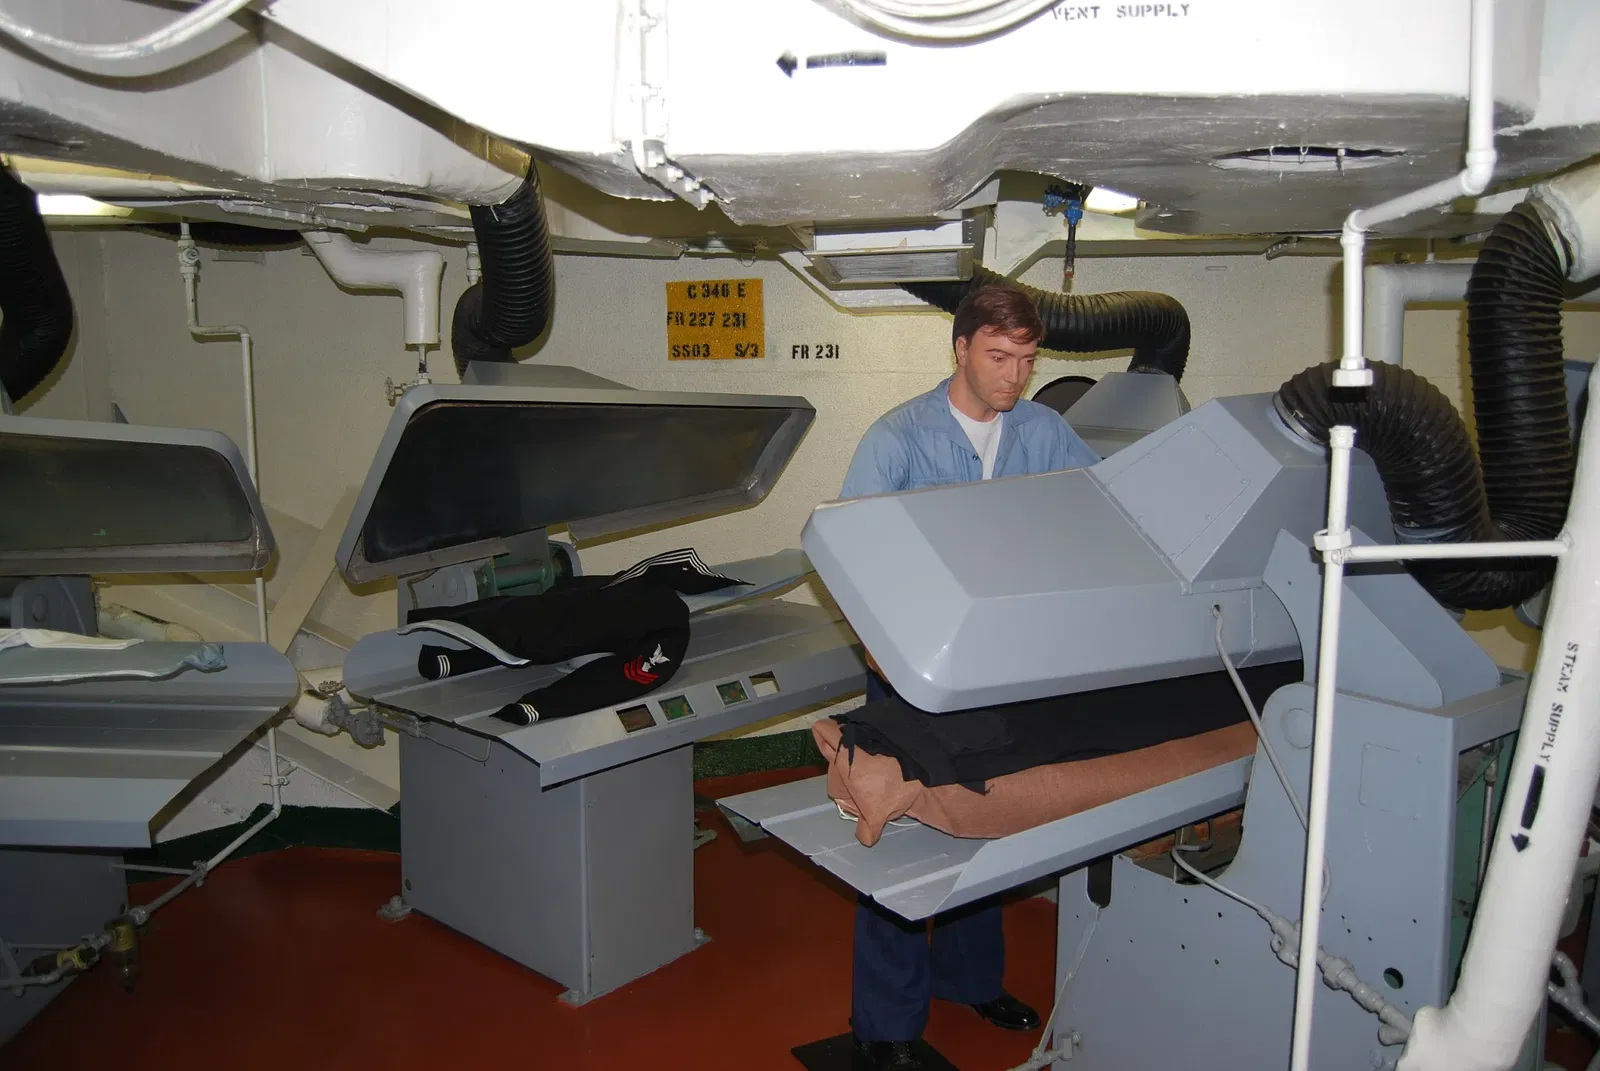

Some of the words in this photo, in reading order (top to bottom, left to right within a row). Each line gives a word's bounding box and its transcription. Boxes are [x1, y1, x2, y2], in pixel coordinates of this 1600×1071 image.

[1051, 6, 1100, 21] VENT
[1116, 4, 1189, 18] SUPPLY
[687, 284, 697, 299] C
[738, 282, 746, 298] E
[667, 312, 684, 326] FR
[689, 312, 715, 327] 227
[722, 312, 747, 328] 231
[672, 343, 711, 358] SS03
[735, 342, 759, 358] S/3
[792, 344, 809, 360] FR
[815, 343, 840, 360] 231
[1556, 641, 1579, 693] STEAM
[1539, 702, 1564, 762] SUPPLY
